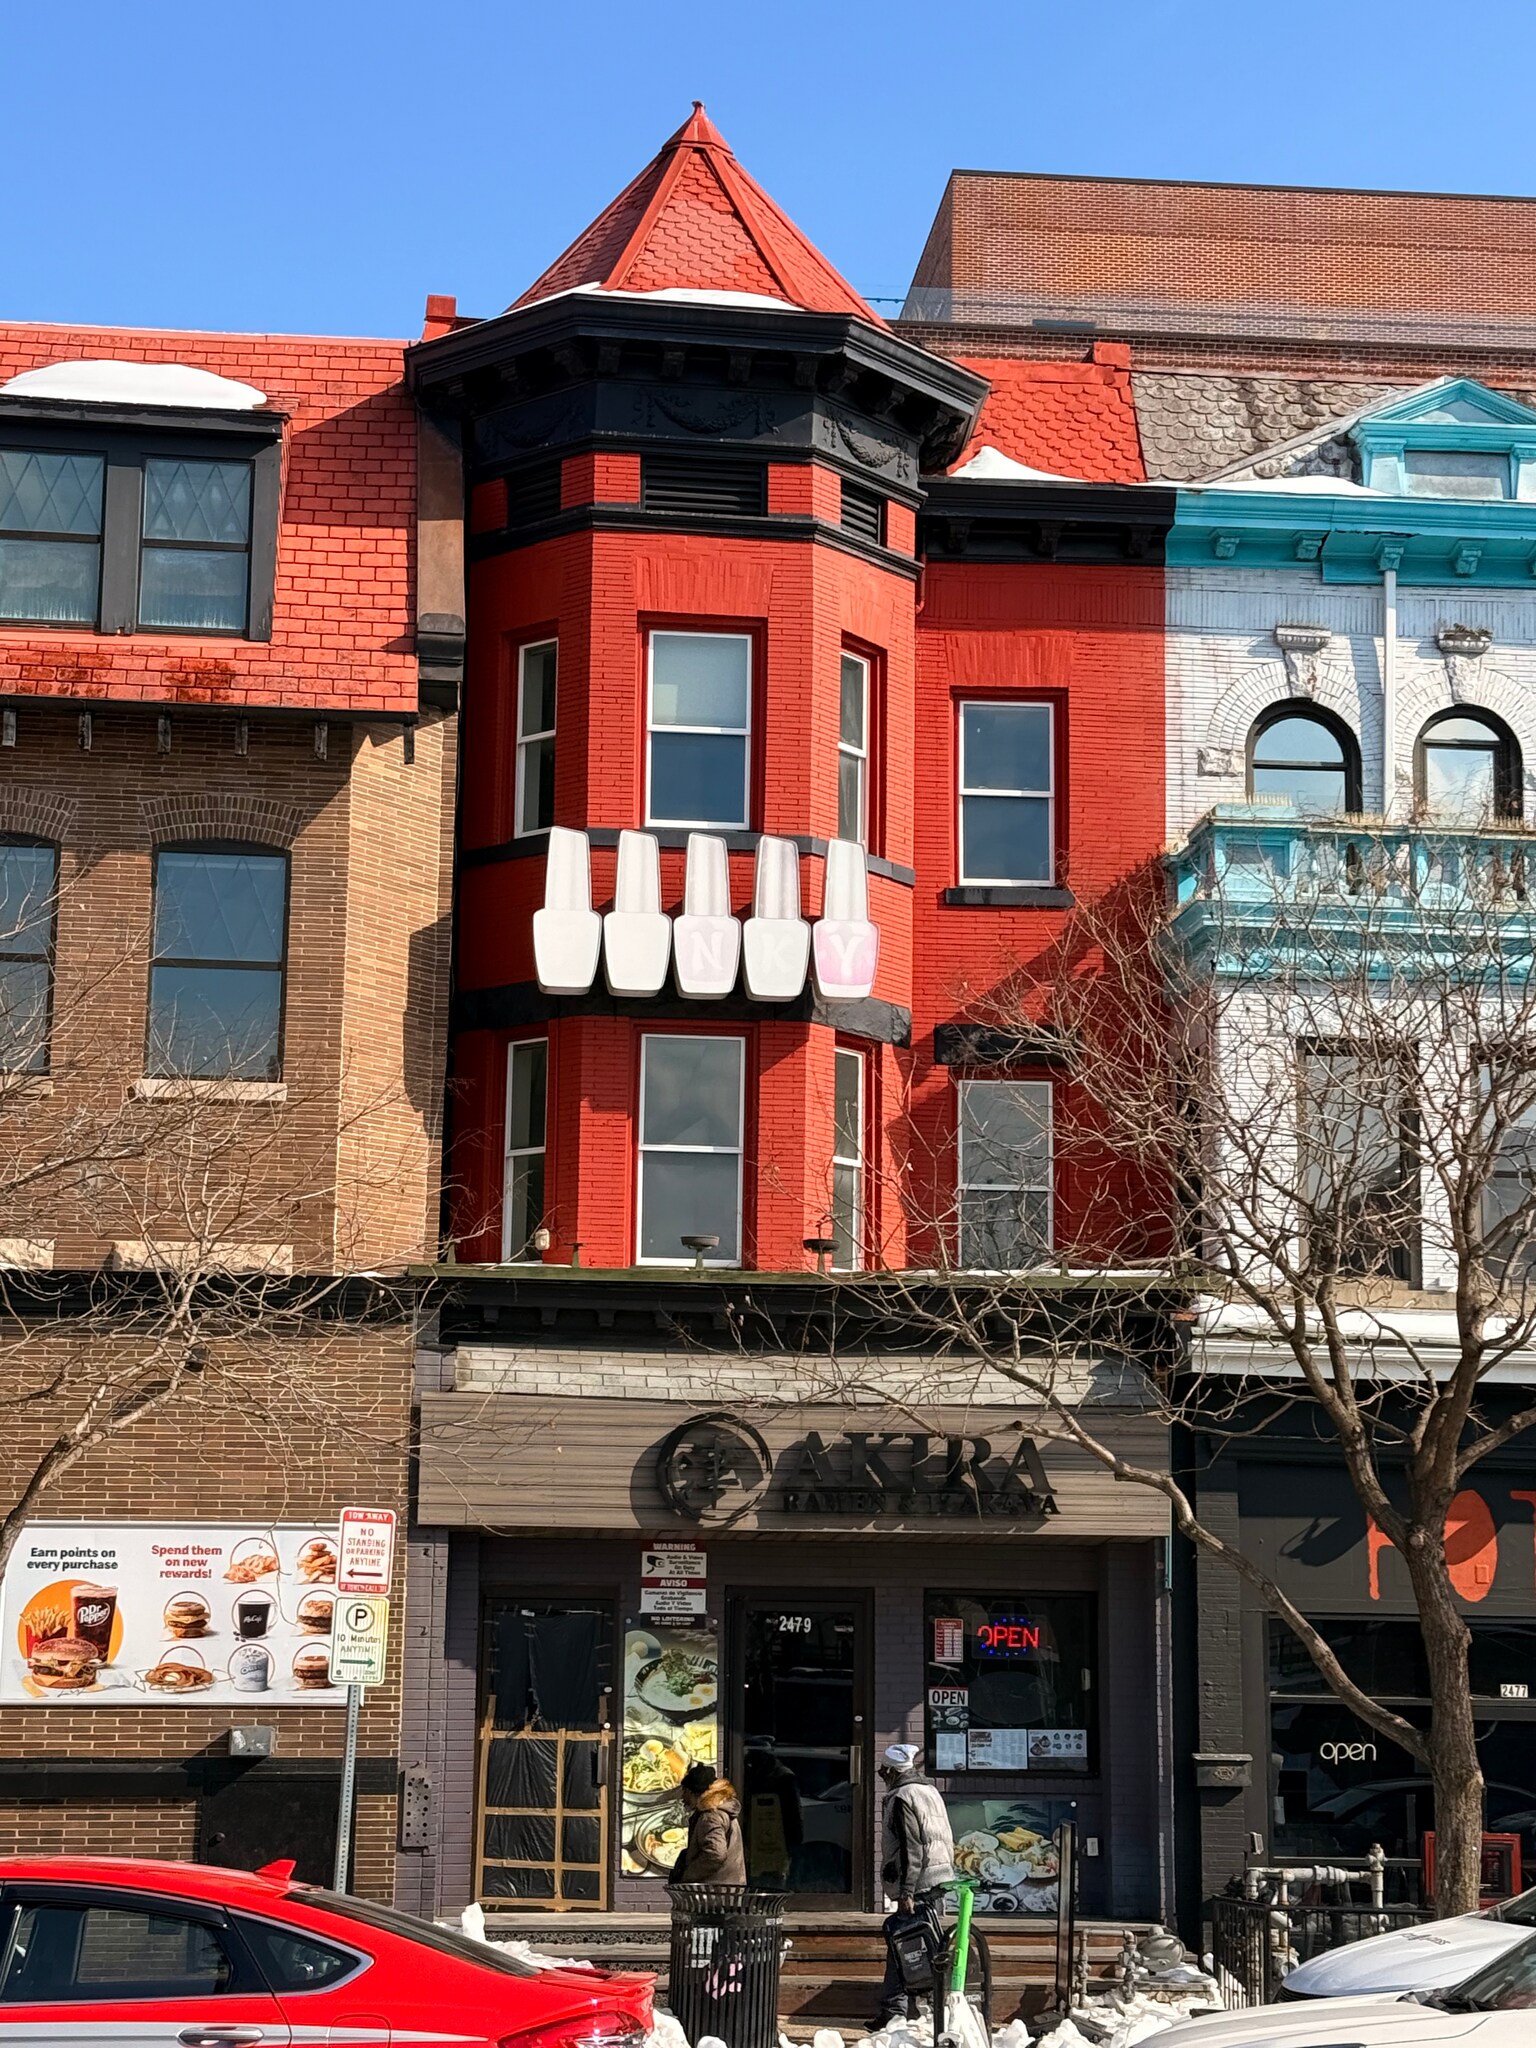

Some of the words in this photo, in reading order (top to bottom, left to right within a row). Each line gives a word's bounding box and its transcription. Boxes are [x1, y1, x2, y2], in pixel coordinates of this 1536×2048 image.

[785, 1431, 1058, 1495] AKIRA
[366, 1512, 389, 1521] AWAY
[360, 1528, 374, 1536] NO
[347, 1537, 386, 1548] STANDING
[653, 1542, 696, 1551] WARNING
[31, 1547, 57, 1557] Earn
[60, 1547, 98, 1560] points
[101, 1549, 116, 1558] on
[151, 1545, 190, 1557] Spend
[191, 1545, 222, 1555] them
[356, 1548, 385, 1557] PARKING
[27, 1560, 60, 1572] every
[62, 1559, 118, 1572] purchase
[165, 1558, 180, 1567] on
[182, 1558, 208, 1567] new
[349, 1557, 381, 1567] ANYTIME
[159, 1568, 212, 1579] rewards!
[660, 1579, 688, 1587] AVISO
[77, 1606, 109, 1624] Pepper
[88, 1603, 102, 1615] Dr
[355, 1608, 368, 1627] P
[779, 1615, 812, 1633] 2479
[337, 1633, 346, 1642] 10
[976, 1624, 1040, 1649] OPEN
[1502, 1685, 1528, 1697] 2477
[931, 1689, 966, 1706] OPEN
[1319, 1741, 1377, 1765] open
